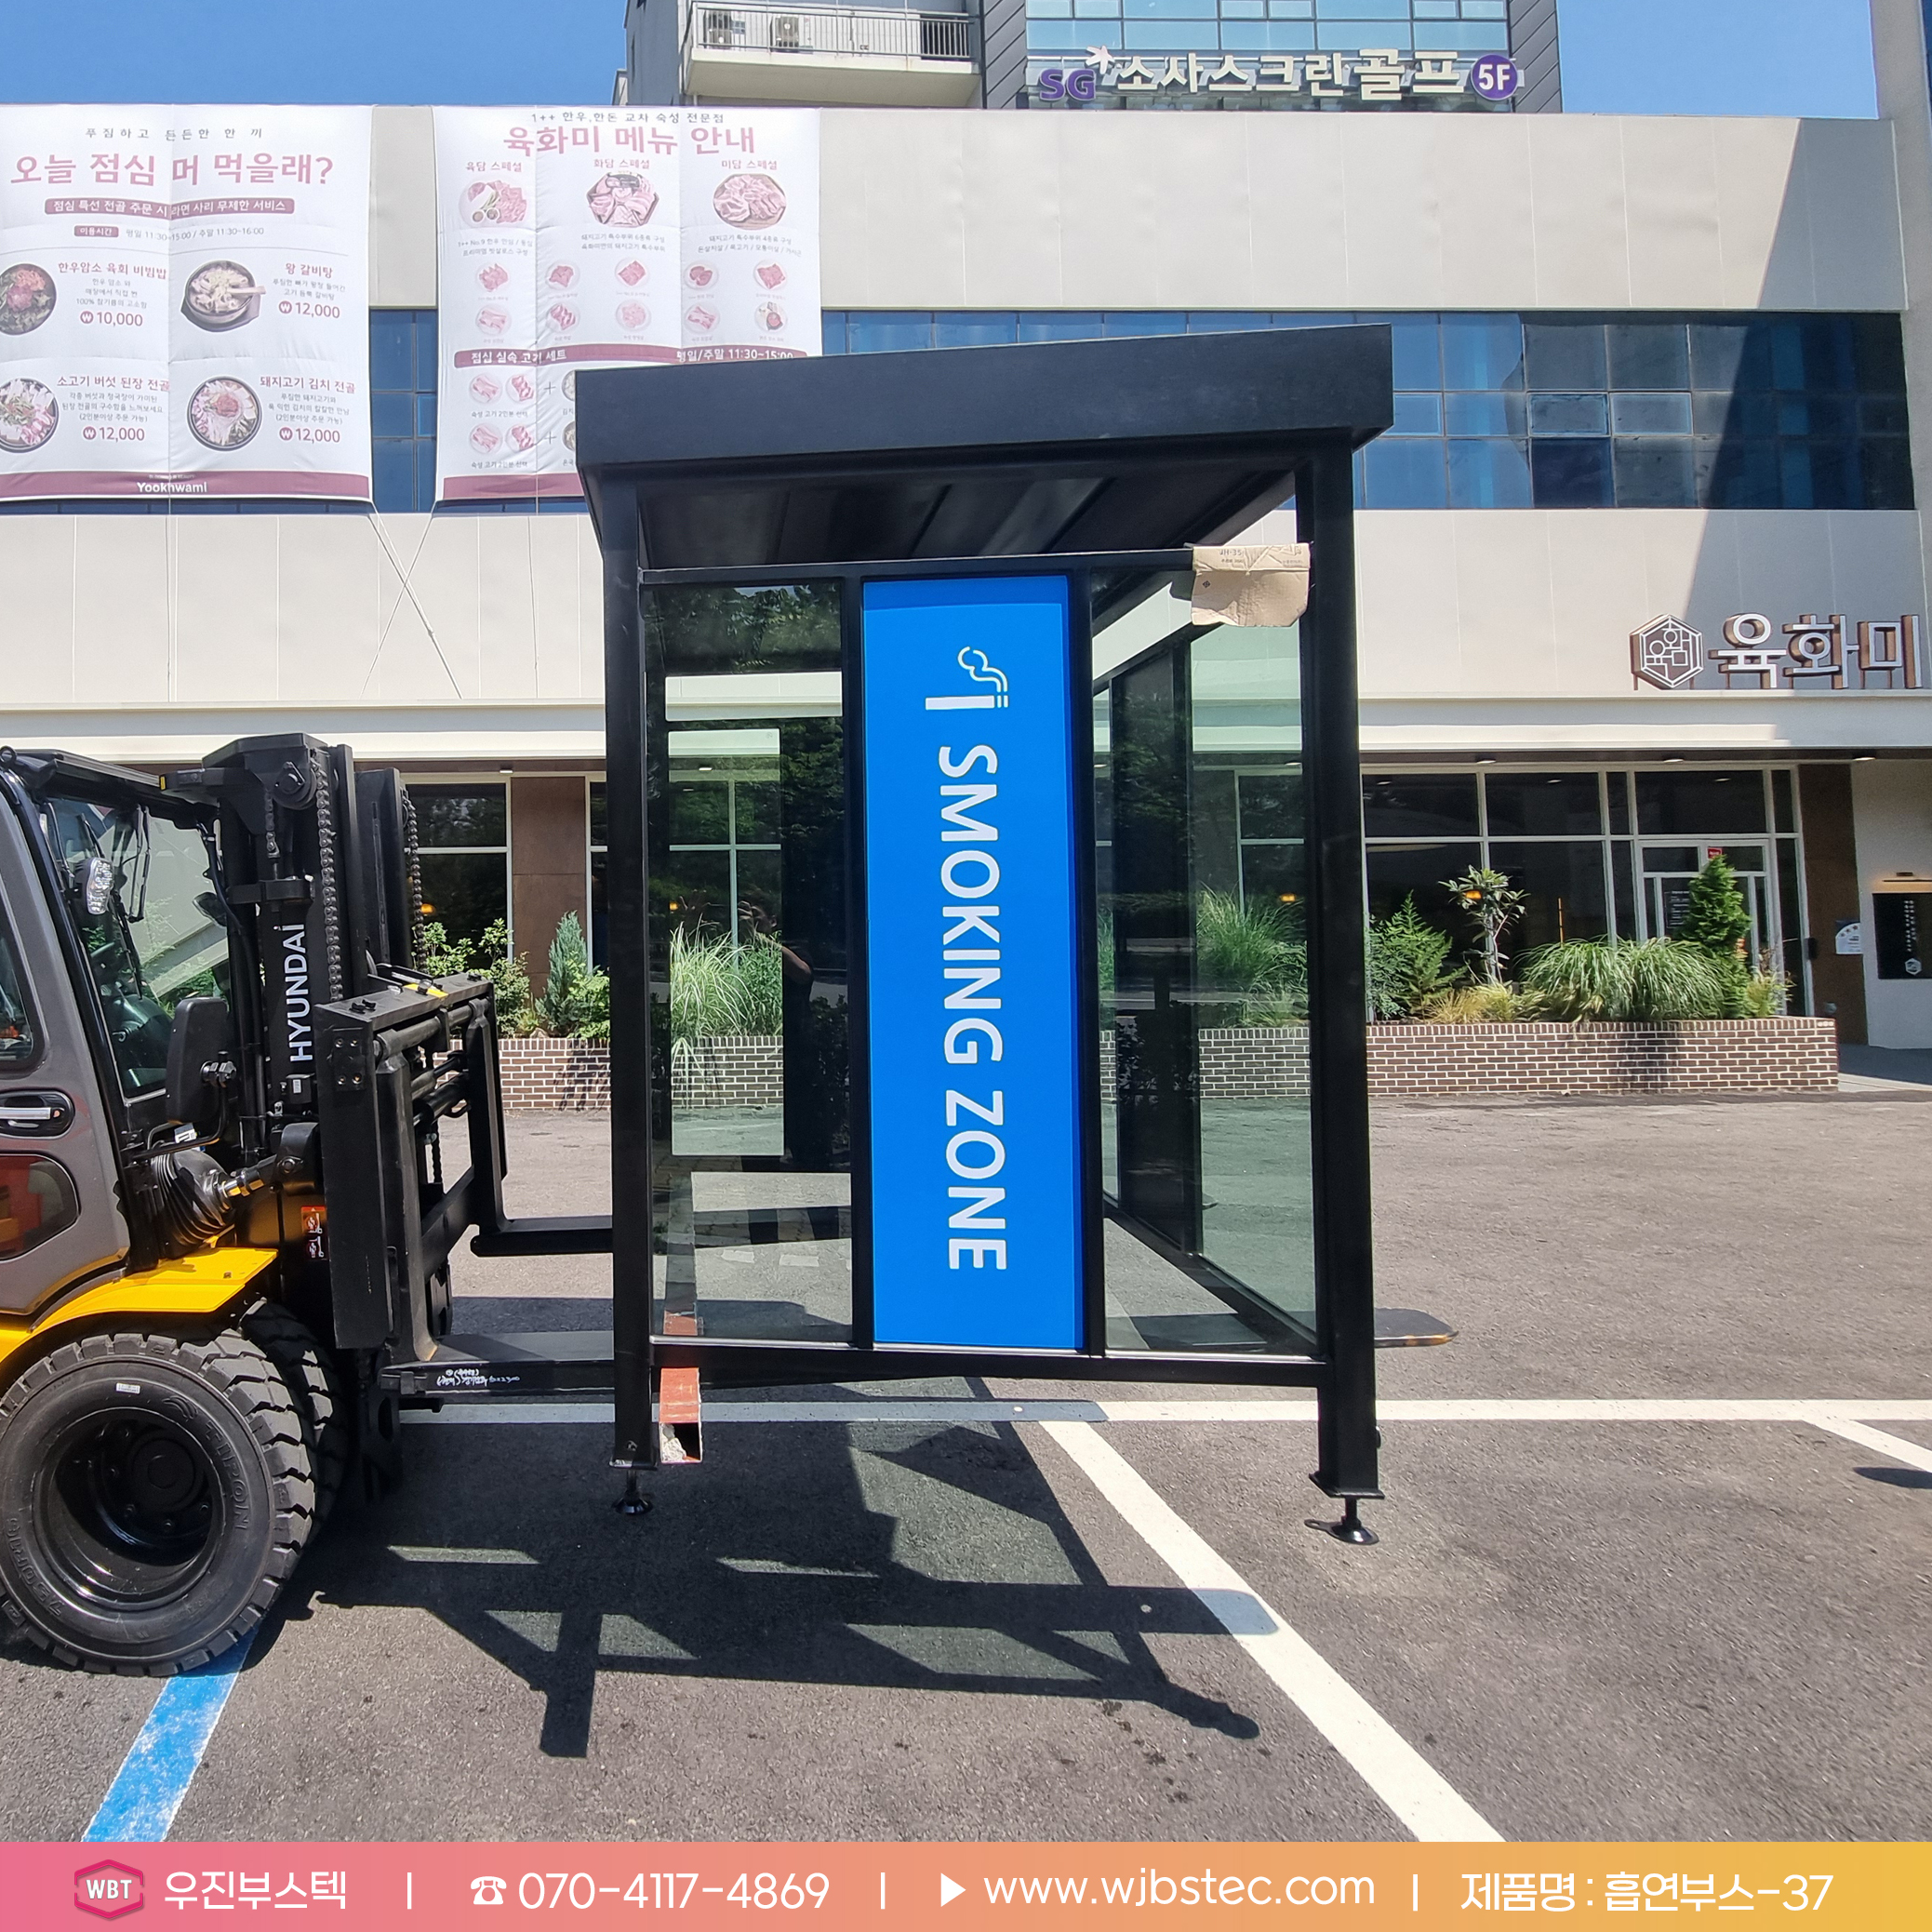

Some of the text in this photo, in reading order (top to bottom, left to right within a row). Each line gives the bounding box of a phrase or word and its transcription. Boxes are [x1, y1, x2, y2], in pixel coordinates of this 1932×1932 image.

[1039, 48, 1511, 100] SG 소사스크린골프 5F
[625, 113, 649, 123] 교차
[656, 112, 679, 124] 숙성
[686, 113, 725, 124] 전문점
[86, 127, 262, 141] 푸짐하고 든든한 한 끼
[503, 125, 754, 156] 육화미 메뉴 안내
[10, 152, 333, 186] 오늘 점심 머 먹을래?
[490, 161, 523, 173] 스페셜
[593, 158, 650, 169] 화담 스페셜
[721, 159, 778, 170] 미담 스페셜
[53, 200, 75, 212] 점심
[78, 199, 100, 212] 특선
[104, 200, 126, 213] 전골
[129, 202, 153, 215] 주문
[156, 205, 167, 218] 시
[193, 201, 214, 214] 사리
[217, 199, 249, 213] 무제한
[253, 200, 286, 212] 서비스
[80, 227, 113, 236] 이용시간
[59, 261, 167, 280] 한우암소 육회 비빔밥
[286, 262, 333, 279] 왕 갈비탕
[472, 352, 492, 364] 점심
[496, 351, 517, 364] 실속
[546, 349, 566, 362] 세트
[57, 376, 90, 387] 소고기
[94, 376, 116, 388] 버섯
[121, 377, 143, 389] 된장
[260, 376, 355, 393] 돼지고기 김치 전골
[1709, 613, 1923, 689] 육화미
[283, 924, 313, 1062] HYUNDAI
[939, 745, 1006, 1270] SMOKING ZONE
